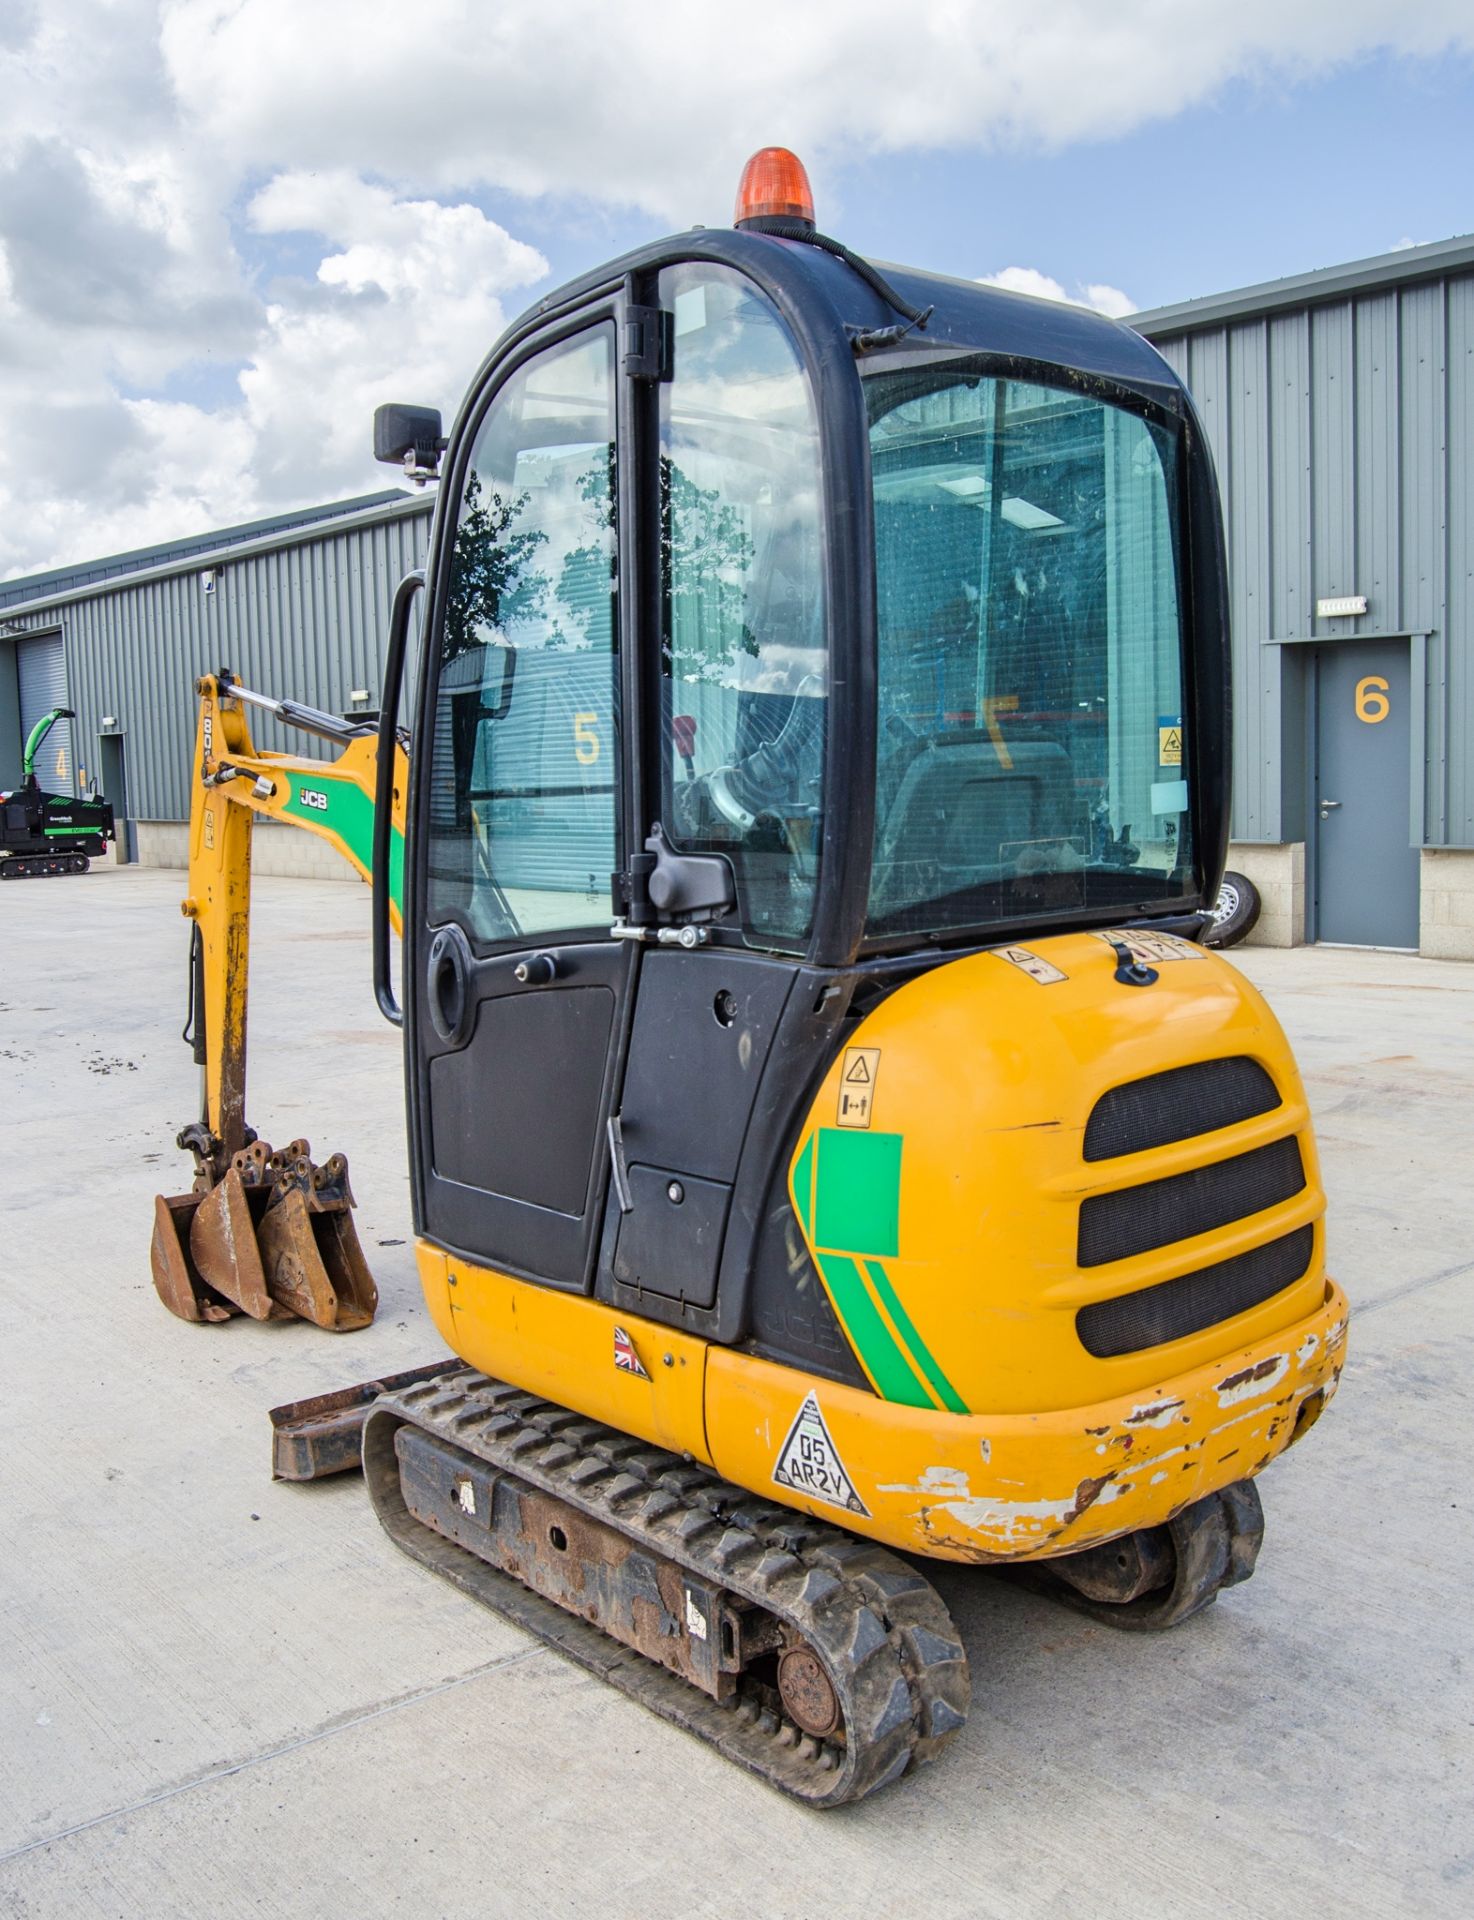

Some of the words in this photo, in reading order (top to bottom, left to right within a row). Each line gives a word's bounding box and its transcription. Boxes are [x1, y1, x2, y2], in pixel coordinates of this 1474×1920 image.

[1355, 676, 1390, 724] 6
[575, 712, 600, 765] 5
[300, 787, 328, 811] JCB
[791, 1458, 841, 1498] AR2Y
